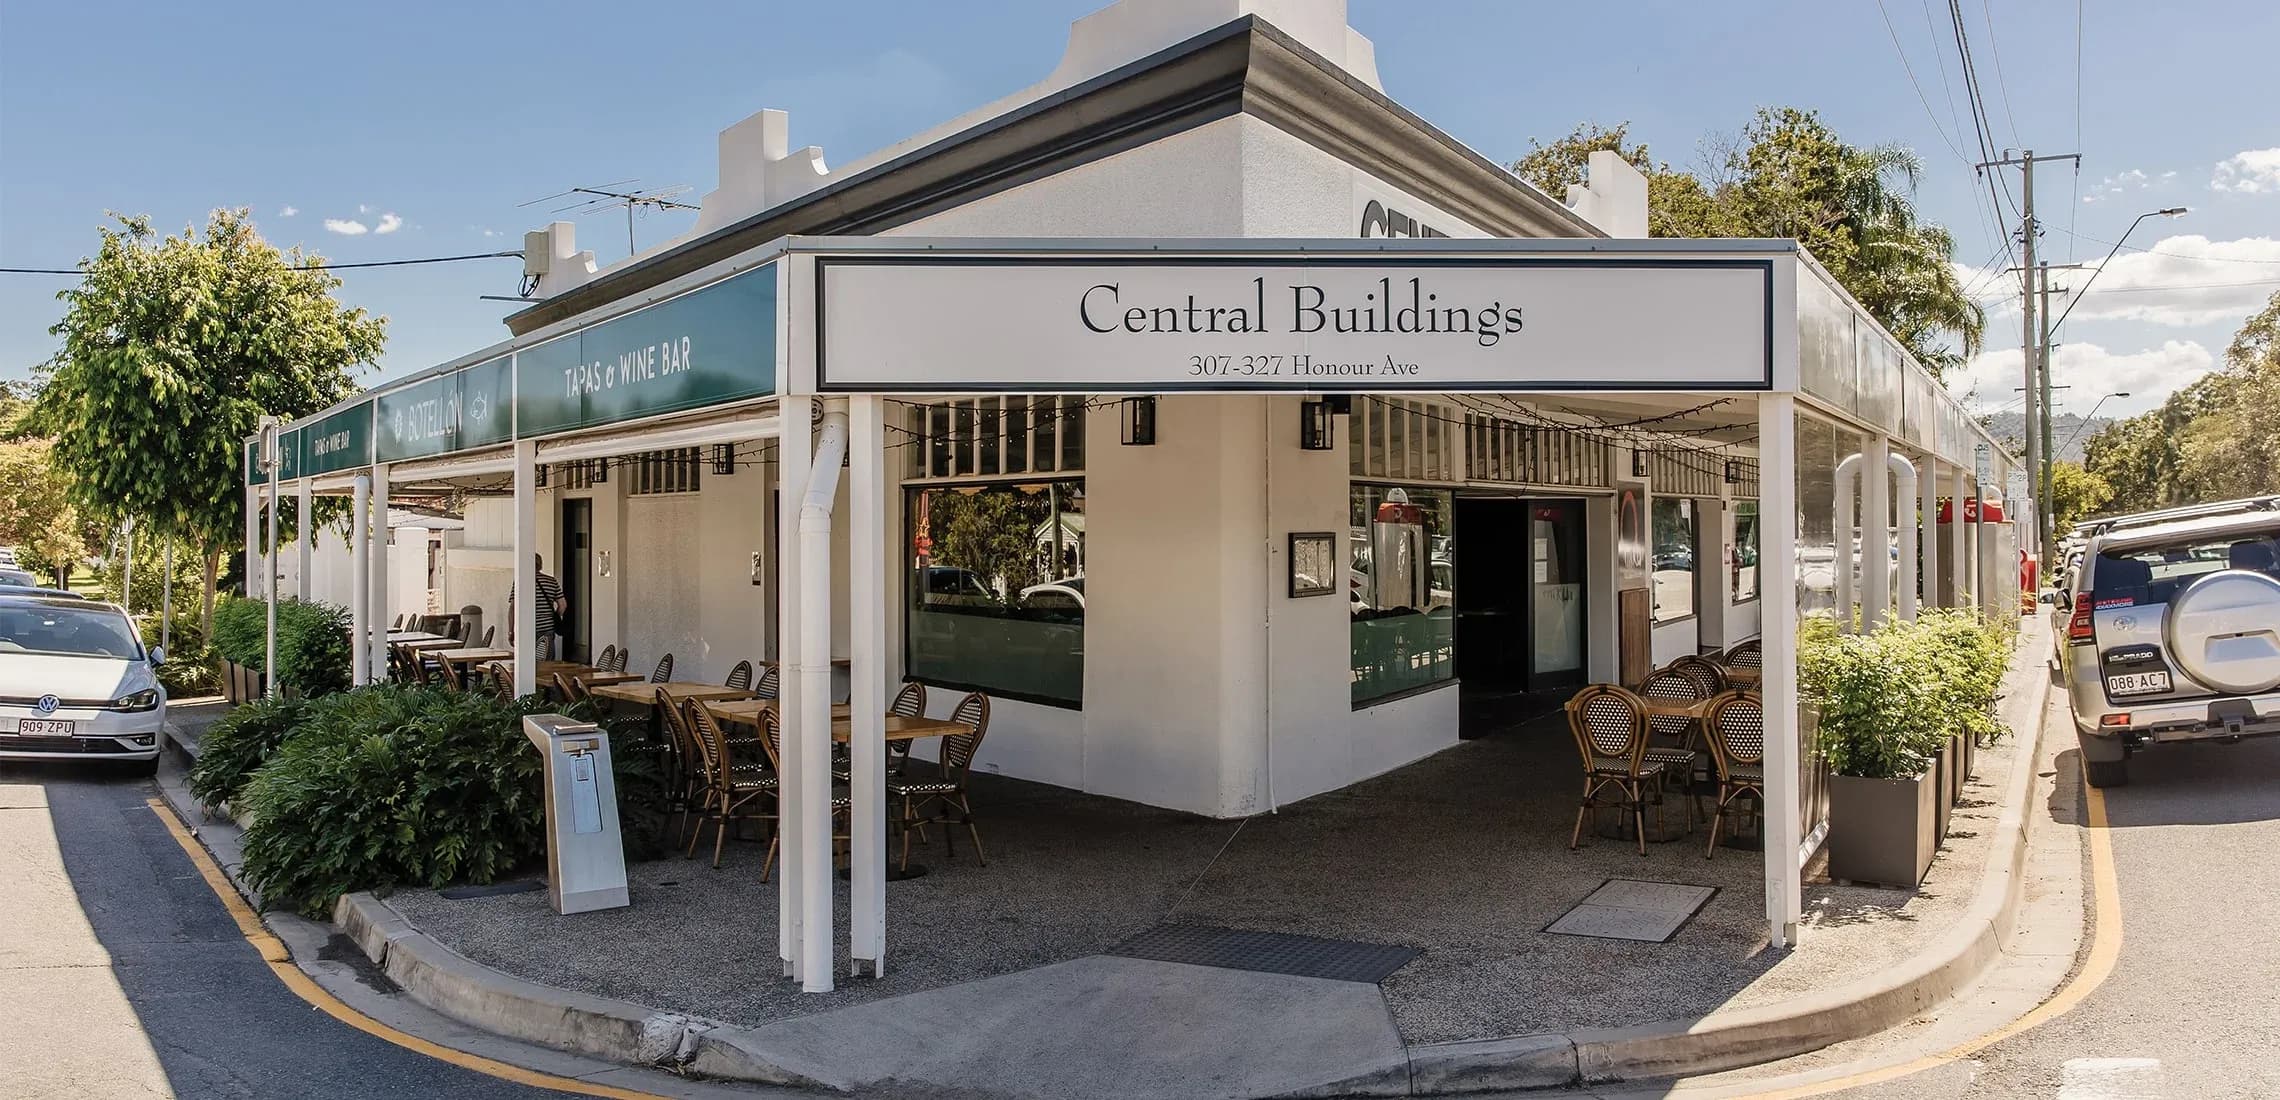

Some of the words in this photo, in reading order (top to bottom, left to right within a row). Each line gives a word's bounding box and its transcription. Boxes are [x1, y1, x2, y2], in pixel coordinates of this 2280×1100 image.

[1080, 277, 1269, 334] Central
[1289, 277, 1524, 347] Buildings
[565, 361, 601, 397] TAPAS
[620, 346, 655, 385] WINE
[662, 336, 690, 376] BAR
[1188, 355, 1284, 376] 307-327
[1292, 354, 1374, 376] Honour
[1381, 354, 1419, 376] Ave
